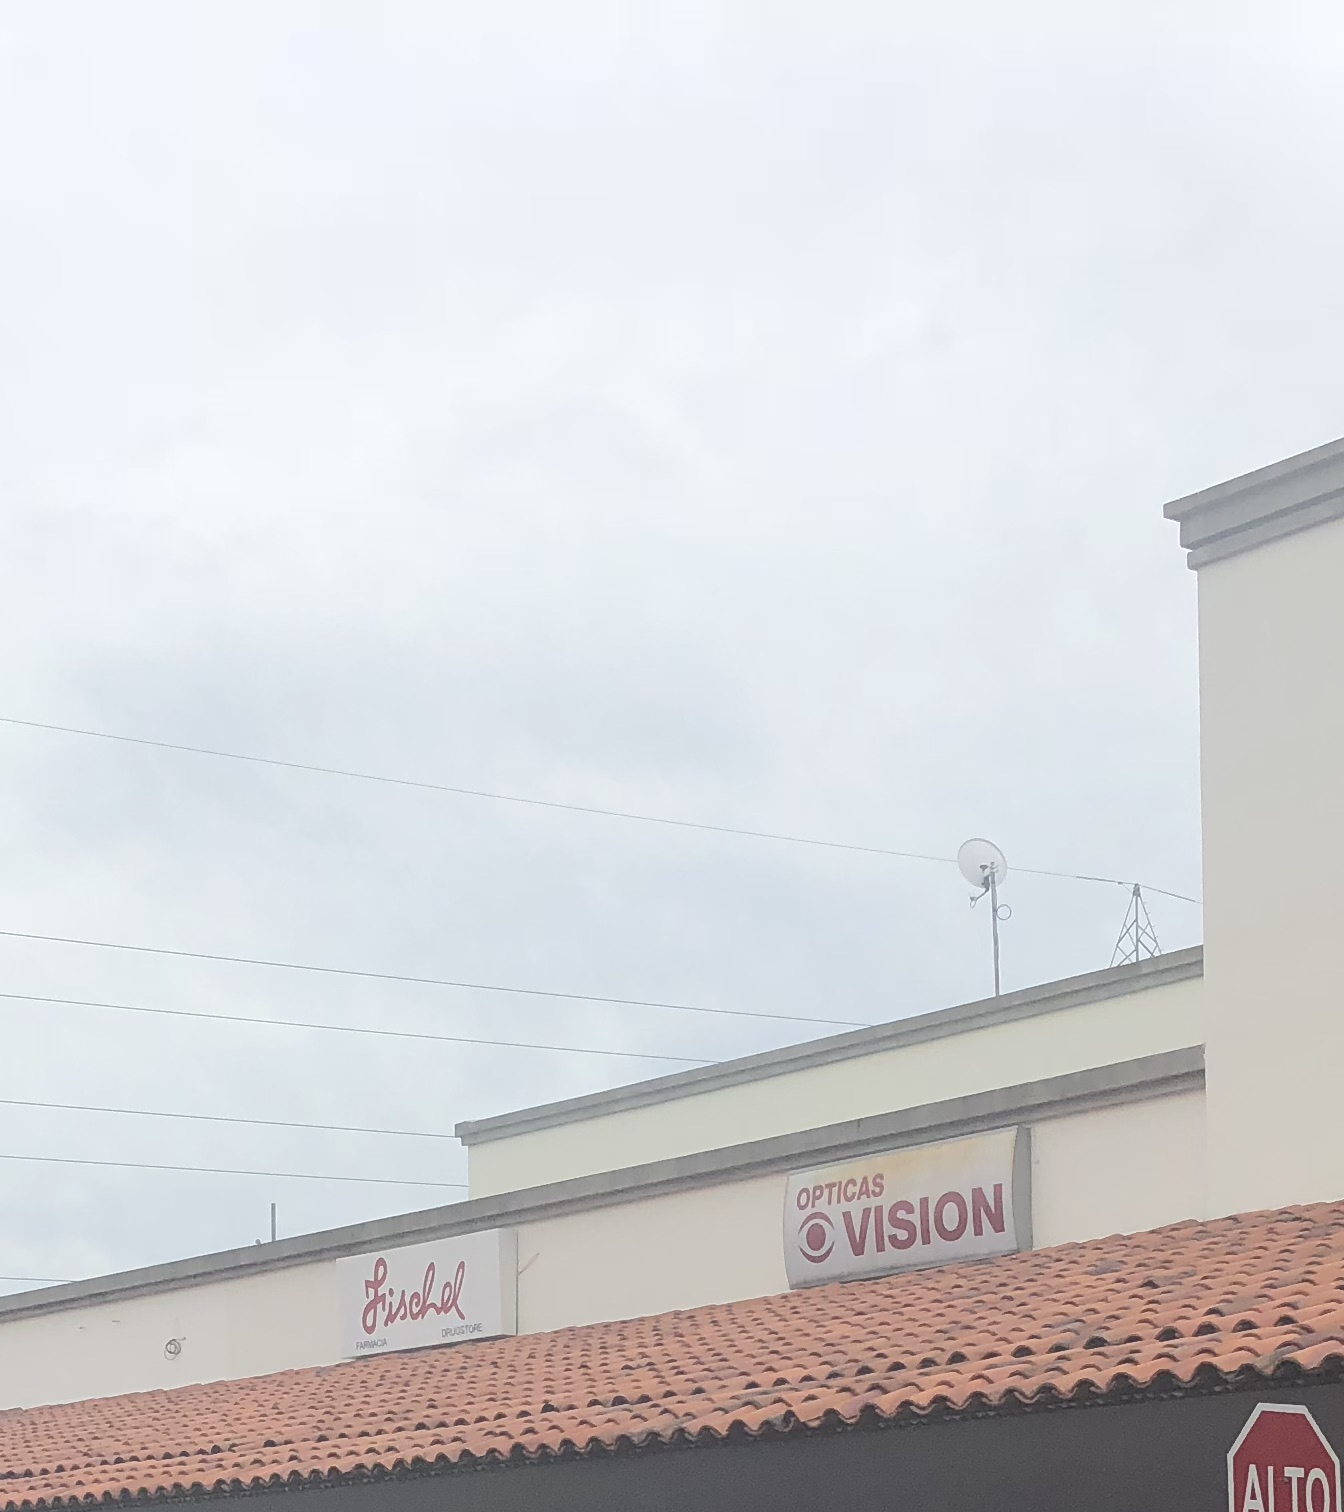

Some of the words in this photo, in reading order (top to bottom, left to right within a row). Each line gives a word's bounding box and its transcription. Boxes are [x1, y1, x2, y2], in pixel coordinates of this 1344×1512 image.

[797, 1173, 884, 1210] OPTICAS
[842, 1183, 1005, 1256] VISION
[362, 1257, 465, 1334] Fischel
[355, 1338, 387, 1350] FARMACIA
[441, 1322, 483, 1337] DRUGSTORE
